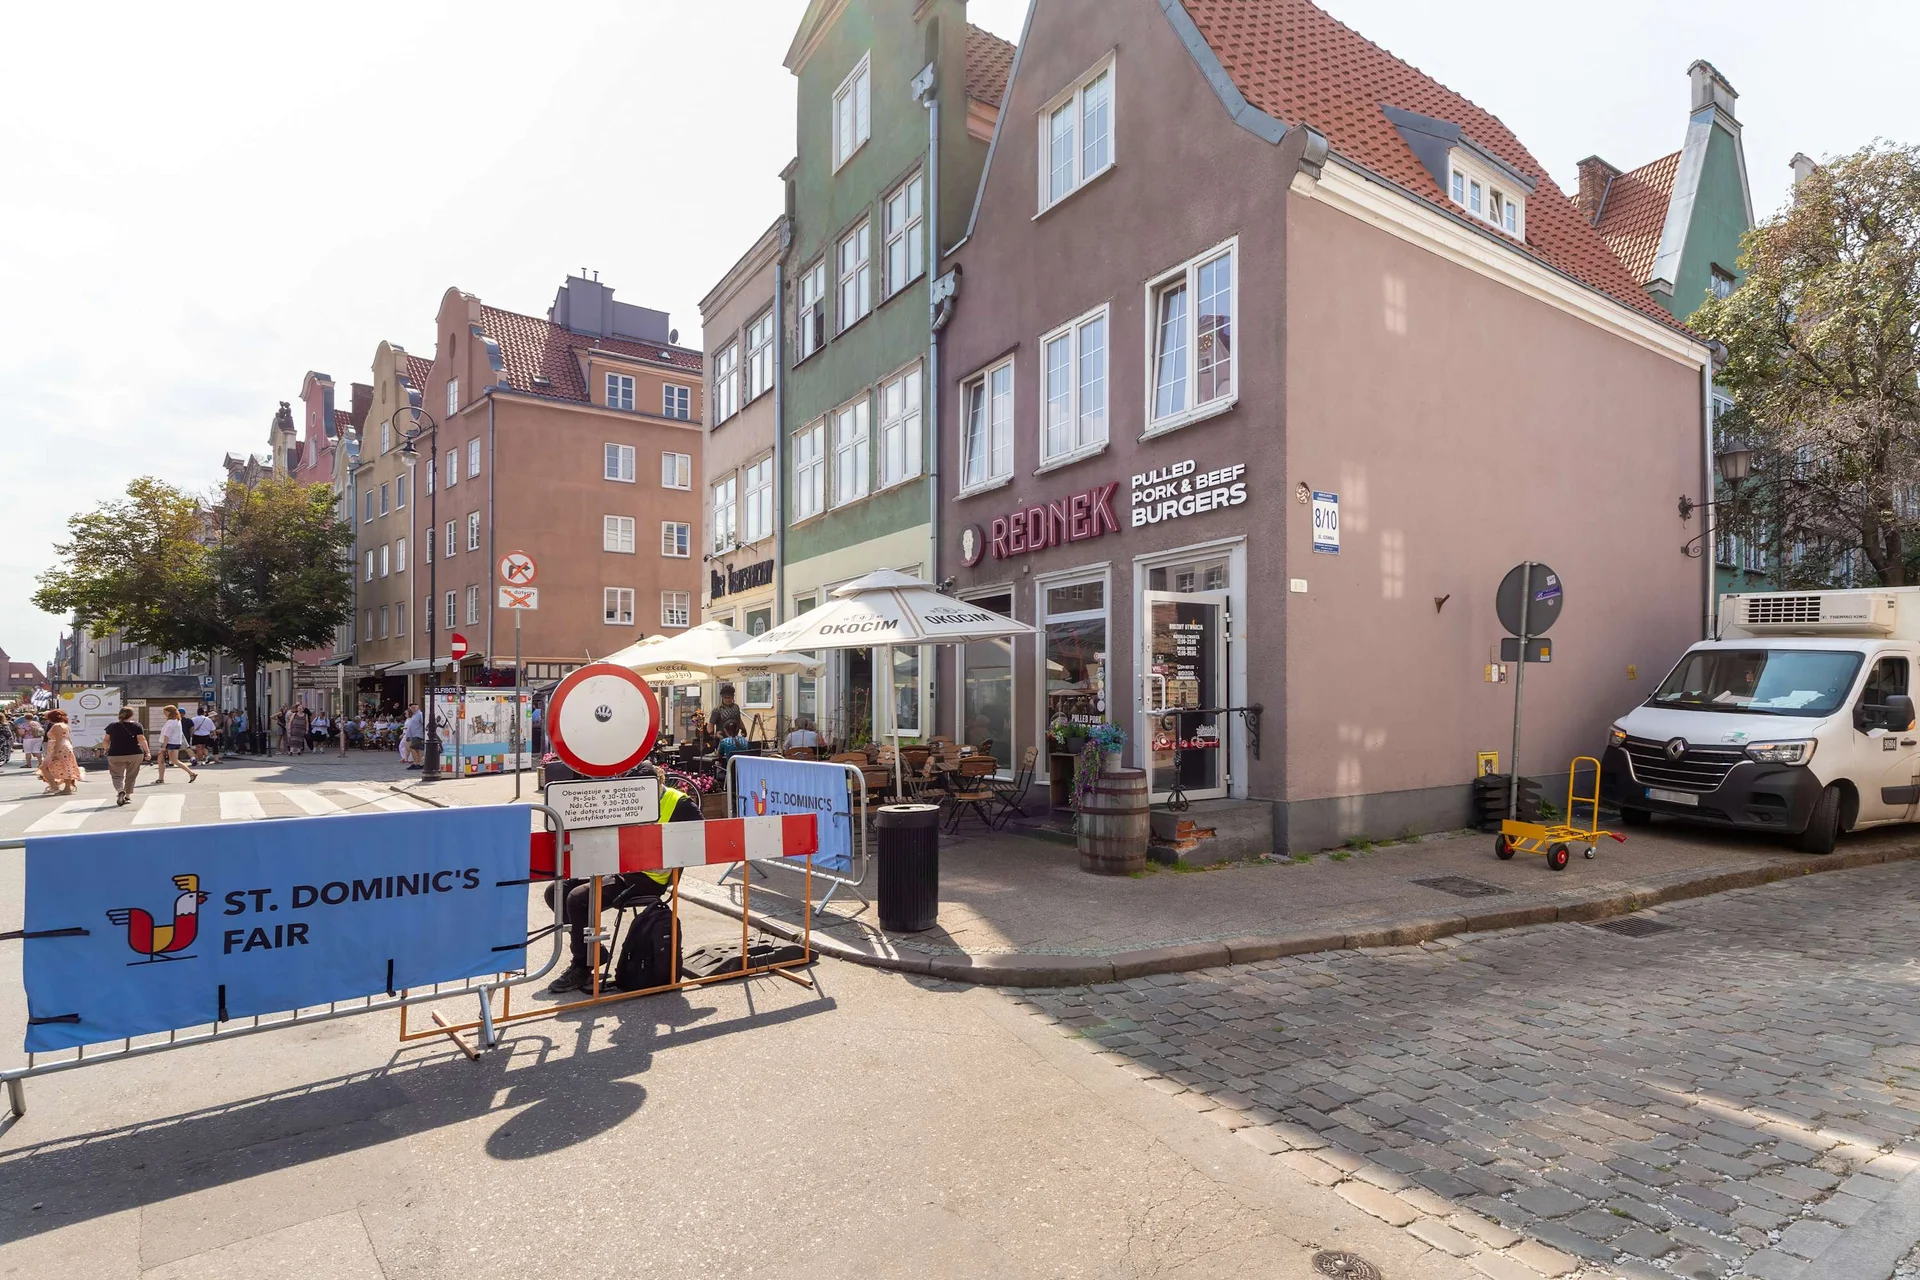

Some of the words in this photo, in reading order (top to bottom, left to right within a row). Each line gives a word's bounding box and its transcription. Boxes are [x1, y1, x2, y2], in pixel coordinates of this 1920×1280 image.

[1131, 459, 1196, 489] PULLED
[1131, 481, 1178, 506] PORK
[1181, 478, 1193, 494] &
[1195, 463, 1245, 490] BEEF
[1131, 482, 1247, 527] BURGERS
[991, 481, 1121, 560] REDNEK
[1314, 507, 1338, 530] 8/10
[819, 618, 899, 636] OKOCIM
[924, 612, 995, 626] OKOCIM
[612, 785, 646, 795] godzinach
[770, 790, 782, 805] ST.
[784, 792, 833, 812] DOMINIC'S
[602, 799, 640, 807] 9.30-20.00
[608, 805, 644, 814] posiadaczy
[223, 888, 278, 916] ST.
[291, 867, 480, 910] DOMINIC'S
[223, 922, 310, 955] FAIR
